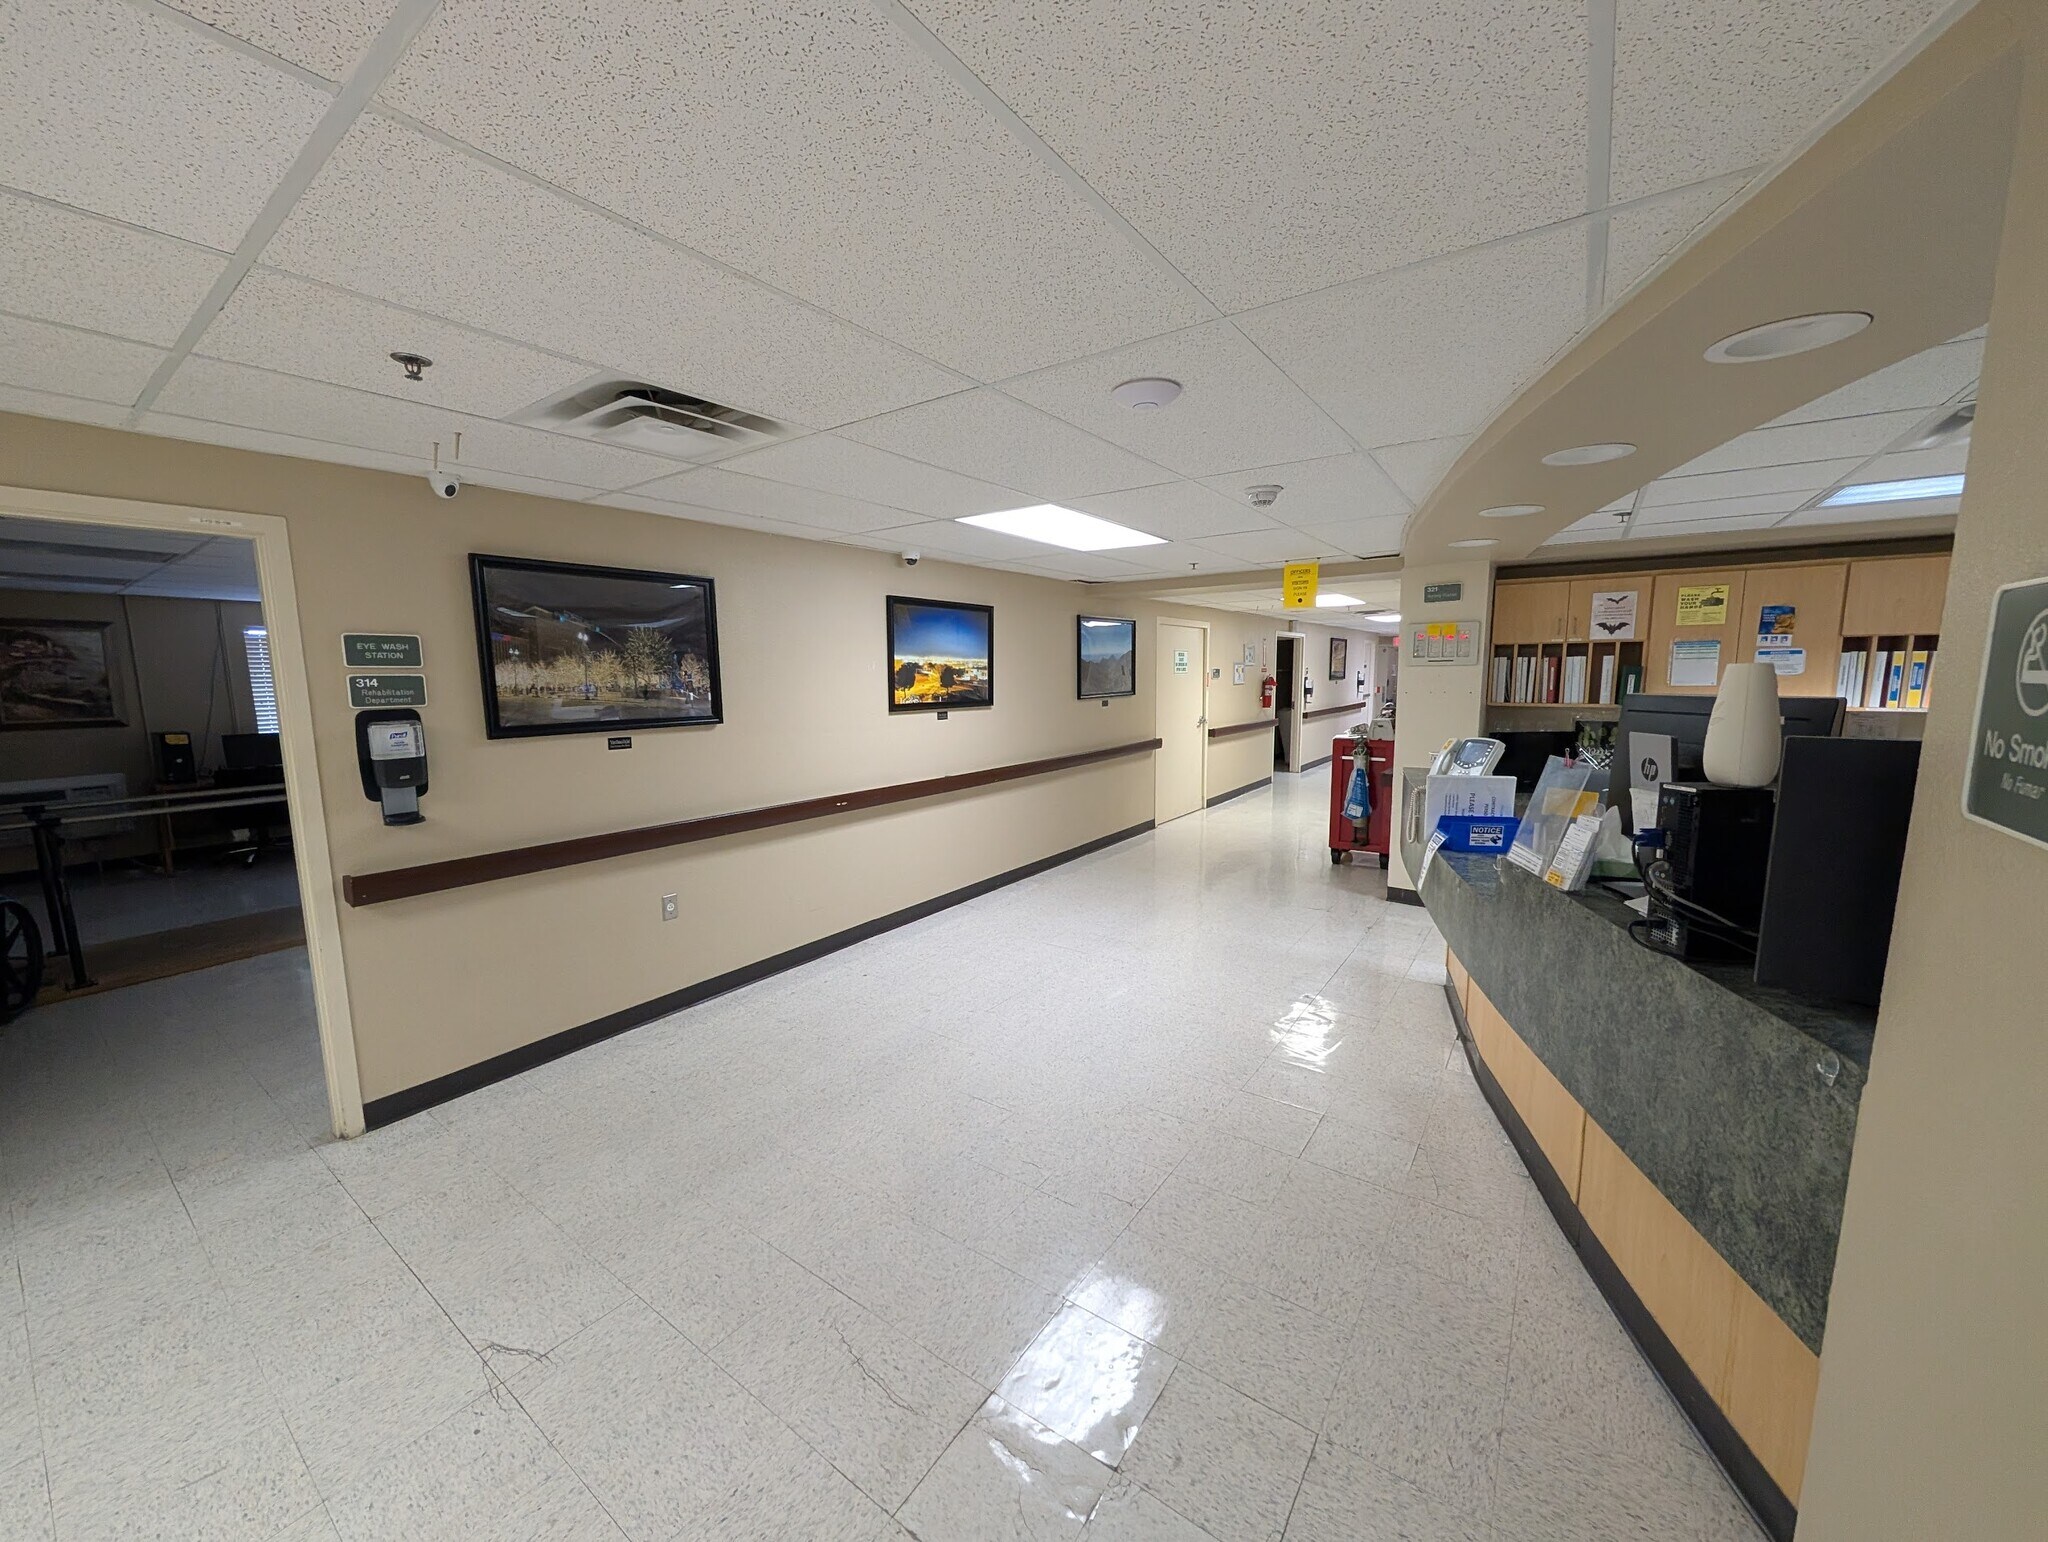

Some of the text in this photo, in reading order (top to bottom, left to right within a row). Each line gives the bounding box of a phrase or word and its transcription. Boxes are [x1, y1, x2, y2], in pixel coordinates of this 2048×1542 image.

[381, 643, 409, 651] WASH
[355, 678, 379, 688] 314
[1984, 730, 2005, 759] No
[1468, 792, 1476, 813] PLEASE
